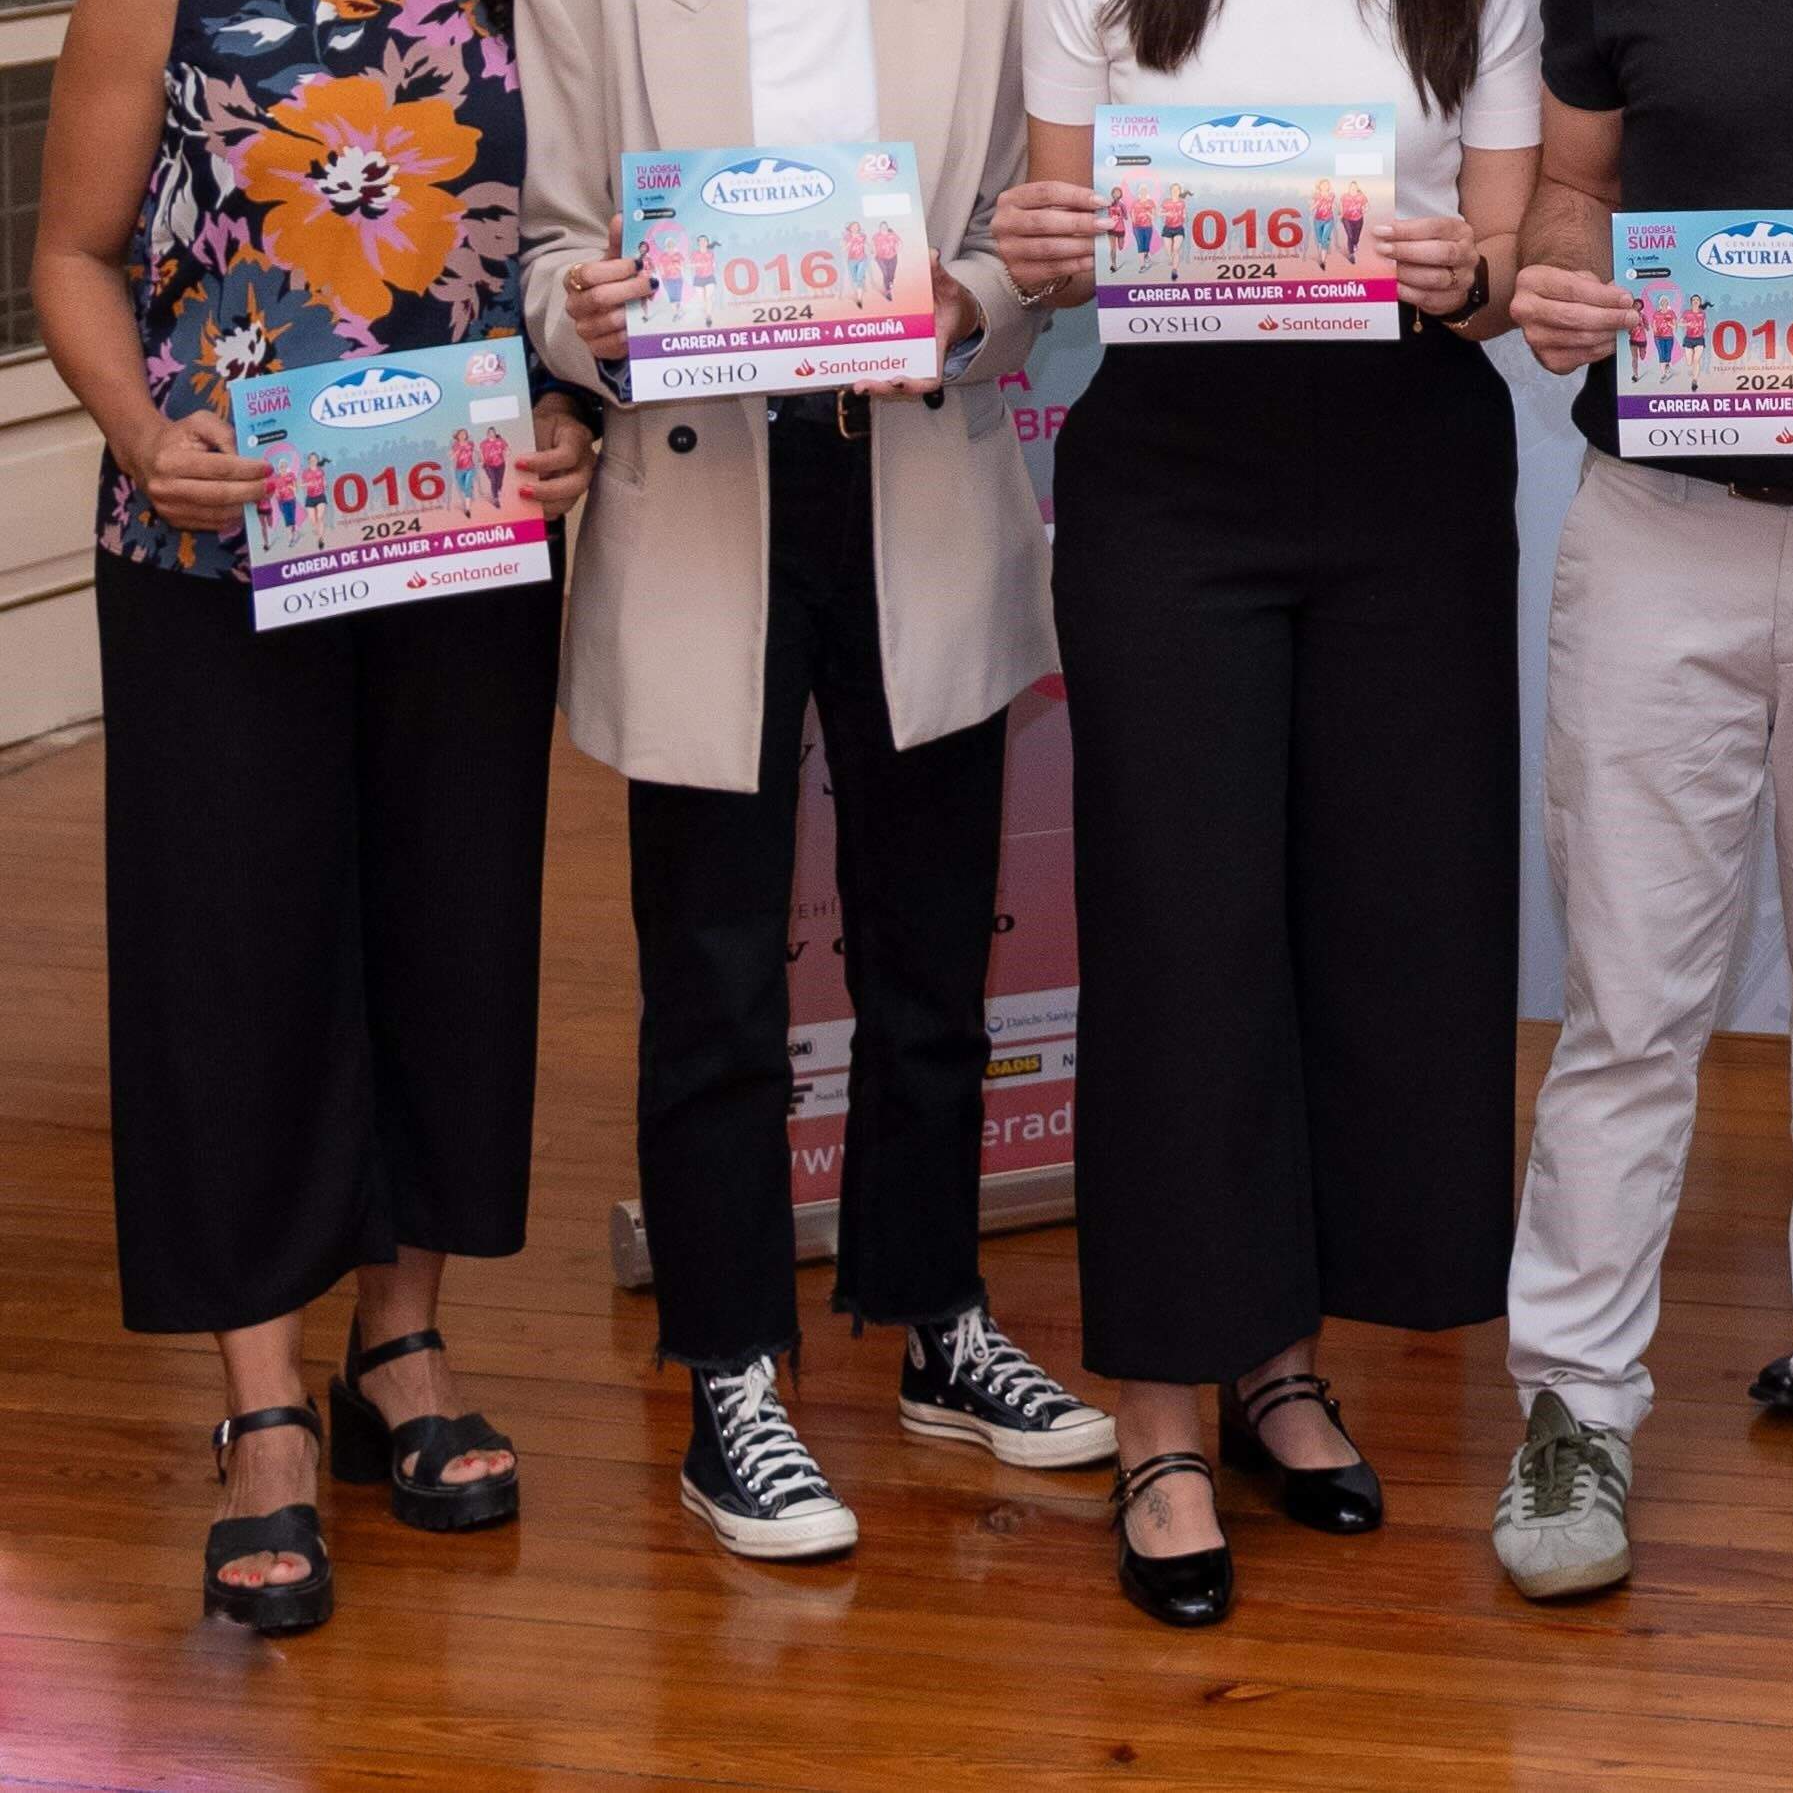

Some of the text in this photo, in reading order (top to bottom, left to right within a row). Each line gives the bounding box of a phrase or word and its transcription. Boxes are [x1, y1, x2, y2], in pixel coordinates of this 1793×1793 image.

[1188, 132, 1300, 153] ASTURIANA
[712, 184, 825, 203] ASTURIANA
[1192, 209, 1303, 249] 016
[1629, 235, 1676, 249] SUMA
[724, 251, 838, 295] 016
[1217, 264, 1277, 279] 2024
[1129, 282, 1365, 301] CARRERA DE LA MUJER A CORUÑA
[752, 305, 813, 323] 2024
[1129, 316, 1221, 333] OYSHO
[1283, 317, 1369, 331] Santander
[663, 320, 904, 351] CARRERA DE LA MUJER A CORUÑA
[663, 363, 757, 387] OYSHO
[819, 356, 907, 374] Santander
[320, 392, 433, 420] ASTURIANA
[1650, 399, 1709, 412] CARRERA
[1714, 399, 1731, 411] DE
[1735, 399, 1751, 410] LA
[1649, 428, 1739, 447] OYSHO
[333, 461, 445, 513] 016
[362, 519, 422, 540] 2024
[282, 527, 514, 578] CARRERA DE LA MUJER A CORUÑA
[431, 561, 520, 585] Santander
[283, 581, 369, 613] OYSHO
